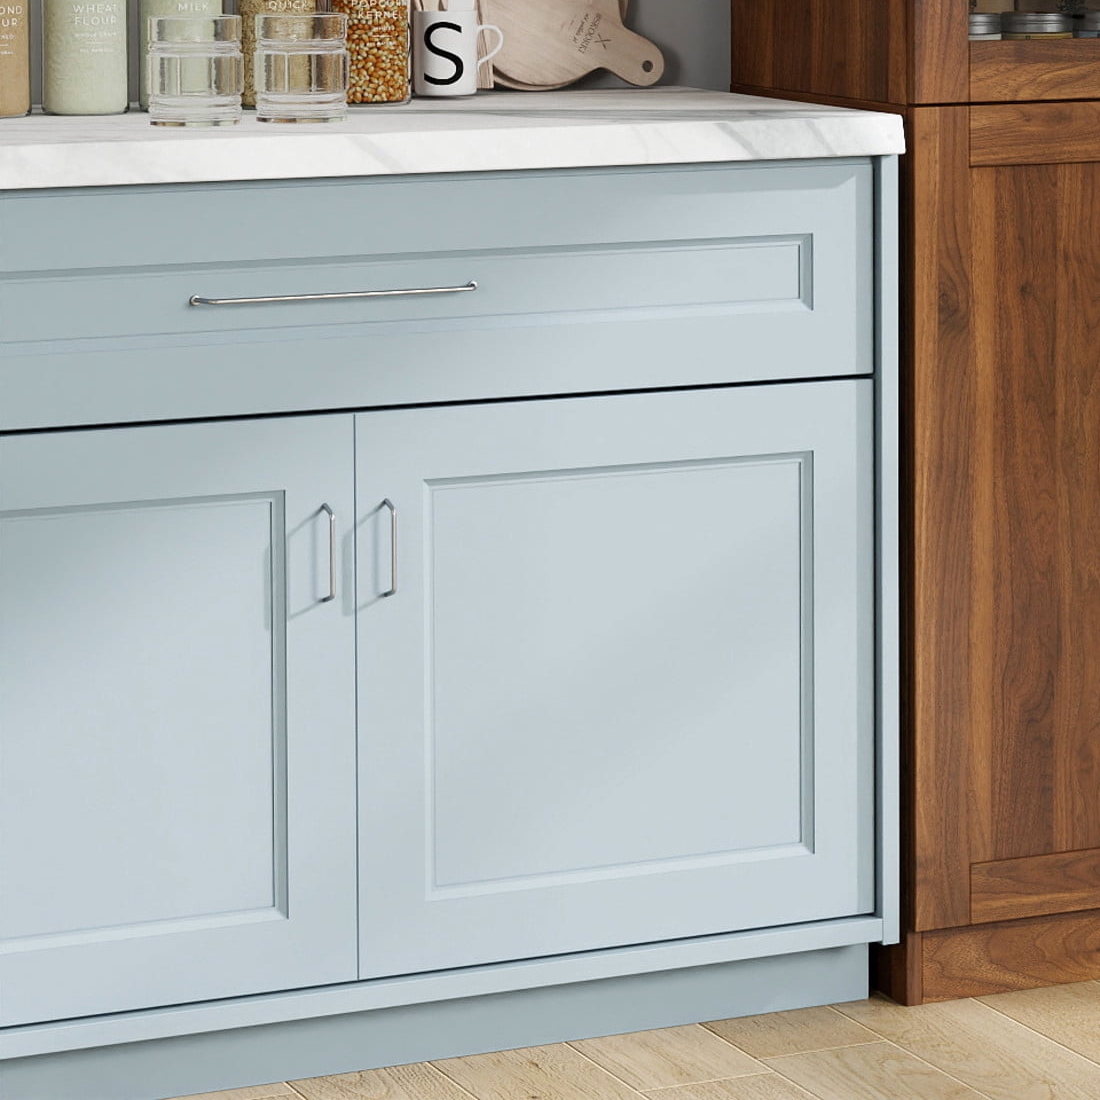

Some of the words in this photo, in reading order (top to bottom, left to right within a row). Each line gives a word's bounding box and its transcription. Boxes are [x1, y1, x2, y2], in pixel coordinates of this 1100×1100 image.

[72, 4, 117, 13] WHEAT
[178, 2, 208, 11] MILK
[74, 16, 117, 26] FLOUR
[424, 22, 464, 85] S
